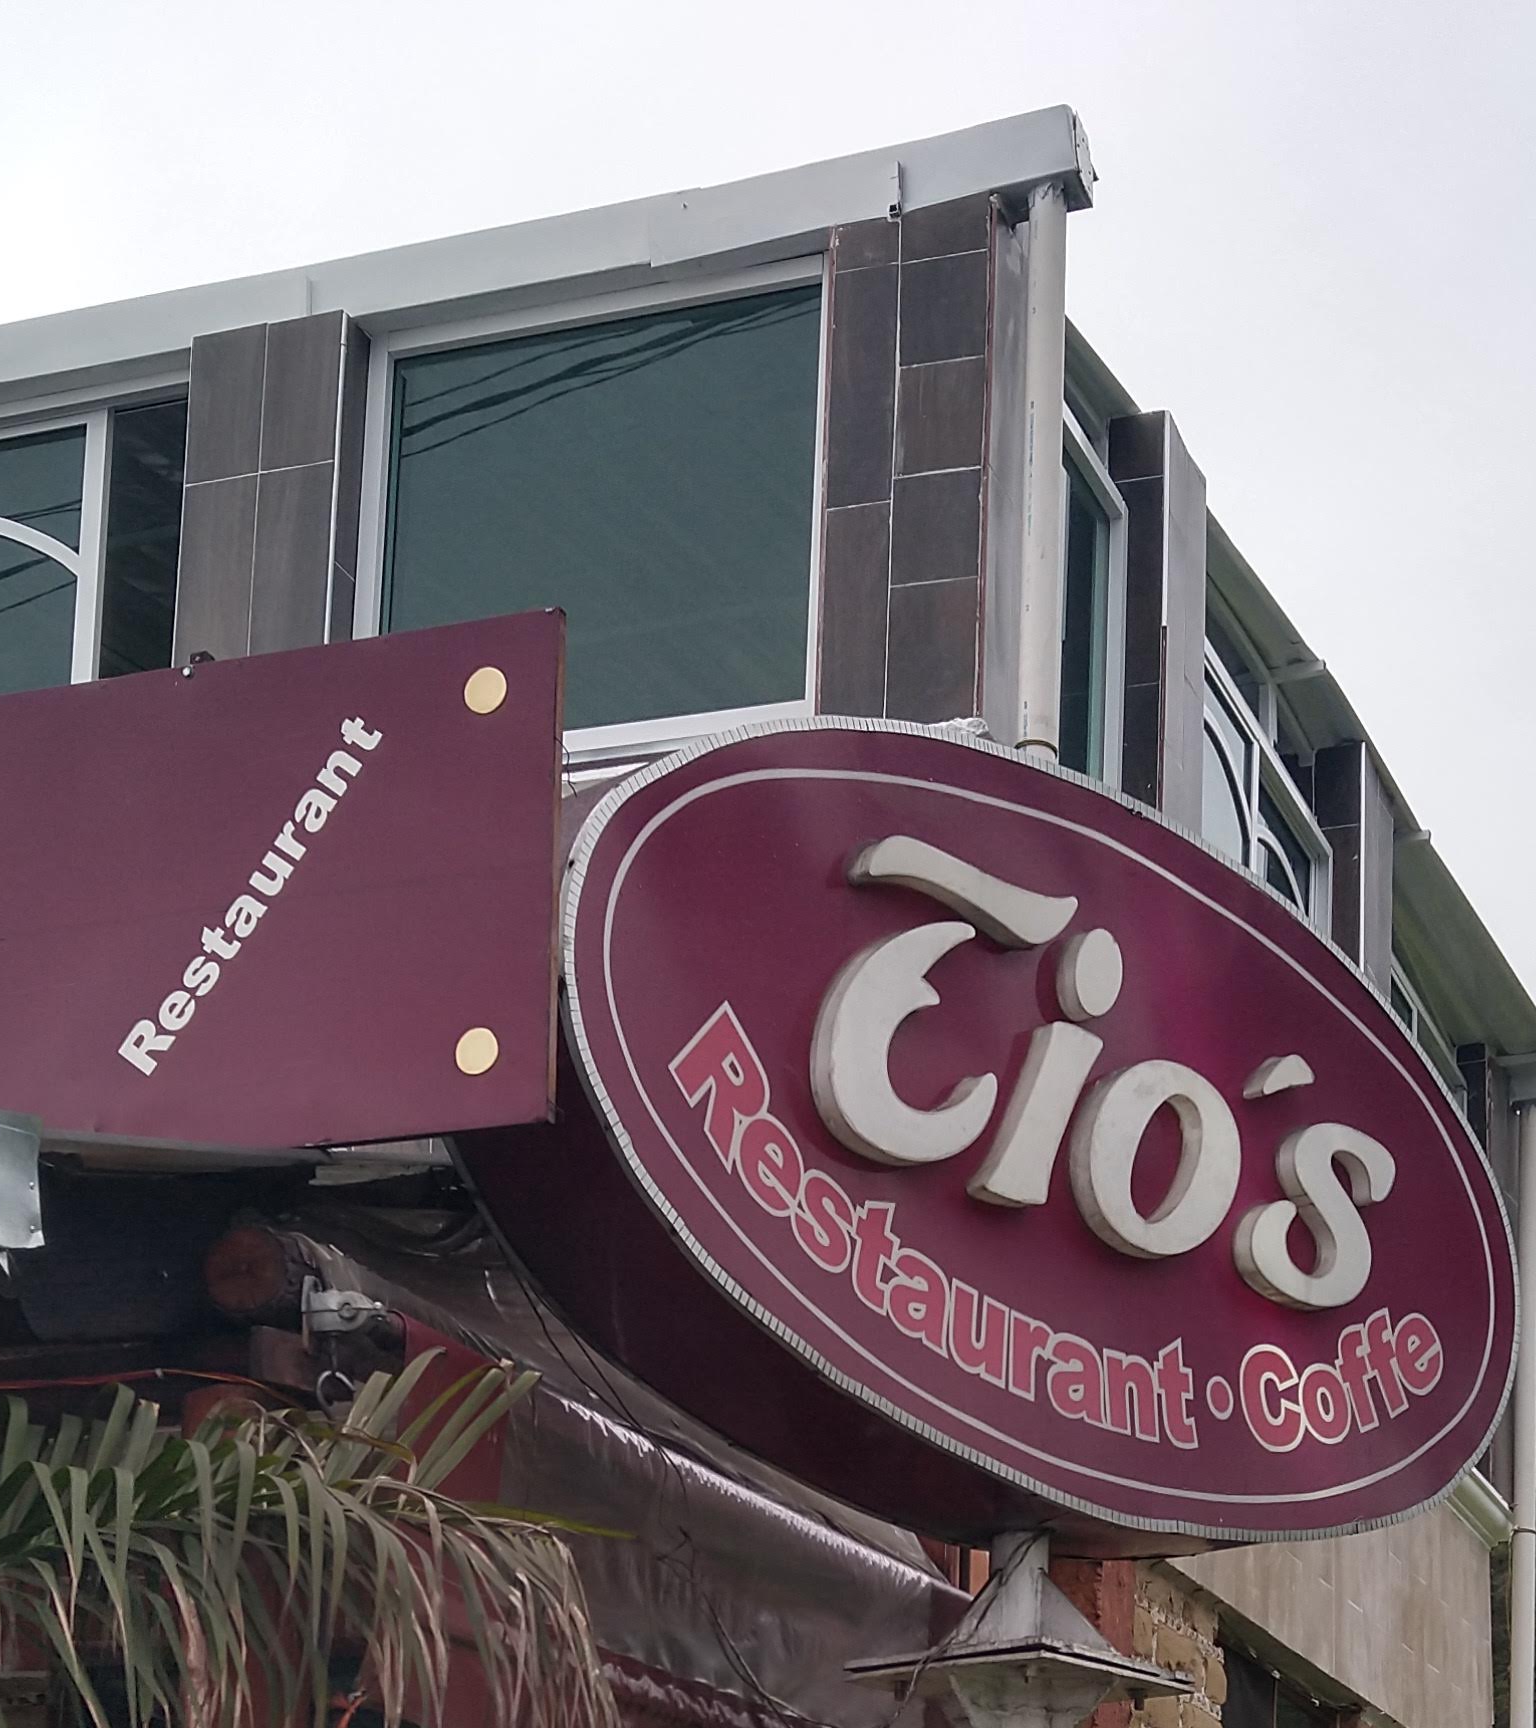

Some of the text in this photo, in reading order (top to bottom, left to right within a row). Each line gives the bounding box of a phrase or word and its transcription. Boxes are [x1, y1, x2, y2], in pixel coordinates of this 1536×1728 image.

[117, 715, 383, 1077] Restaurant
[810, 835, 1397, 1311] Tio's
[668, 1002, 1444, 1453] Restaurant Coffe
